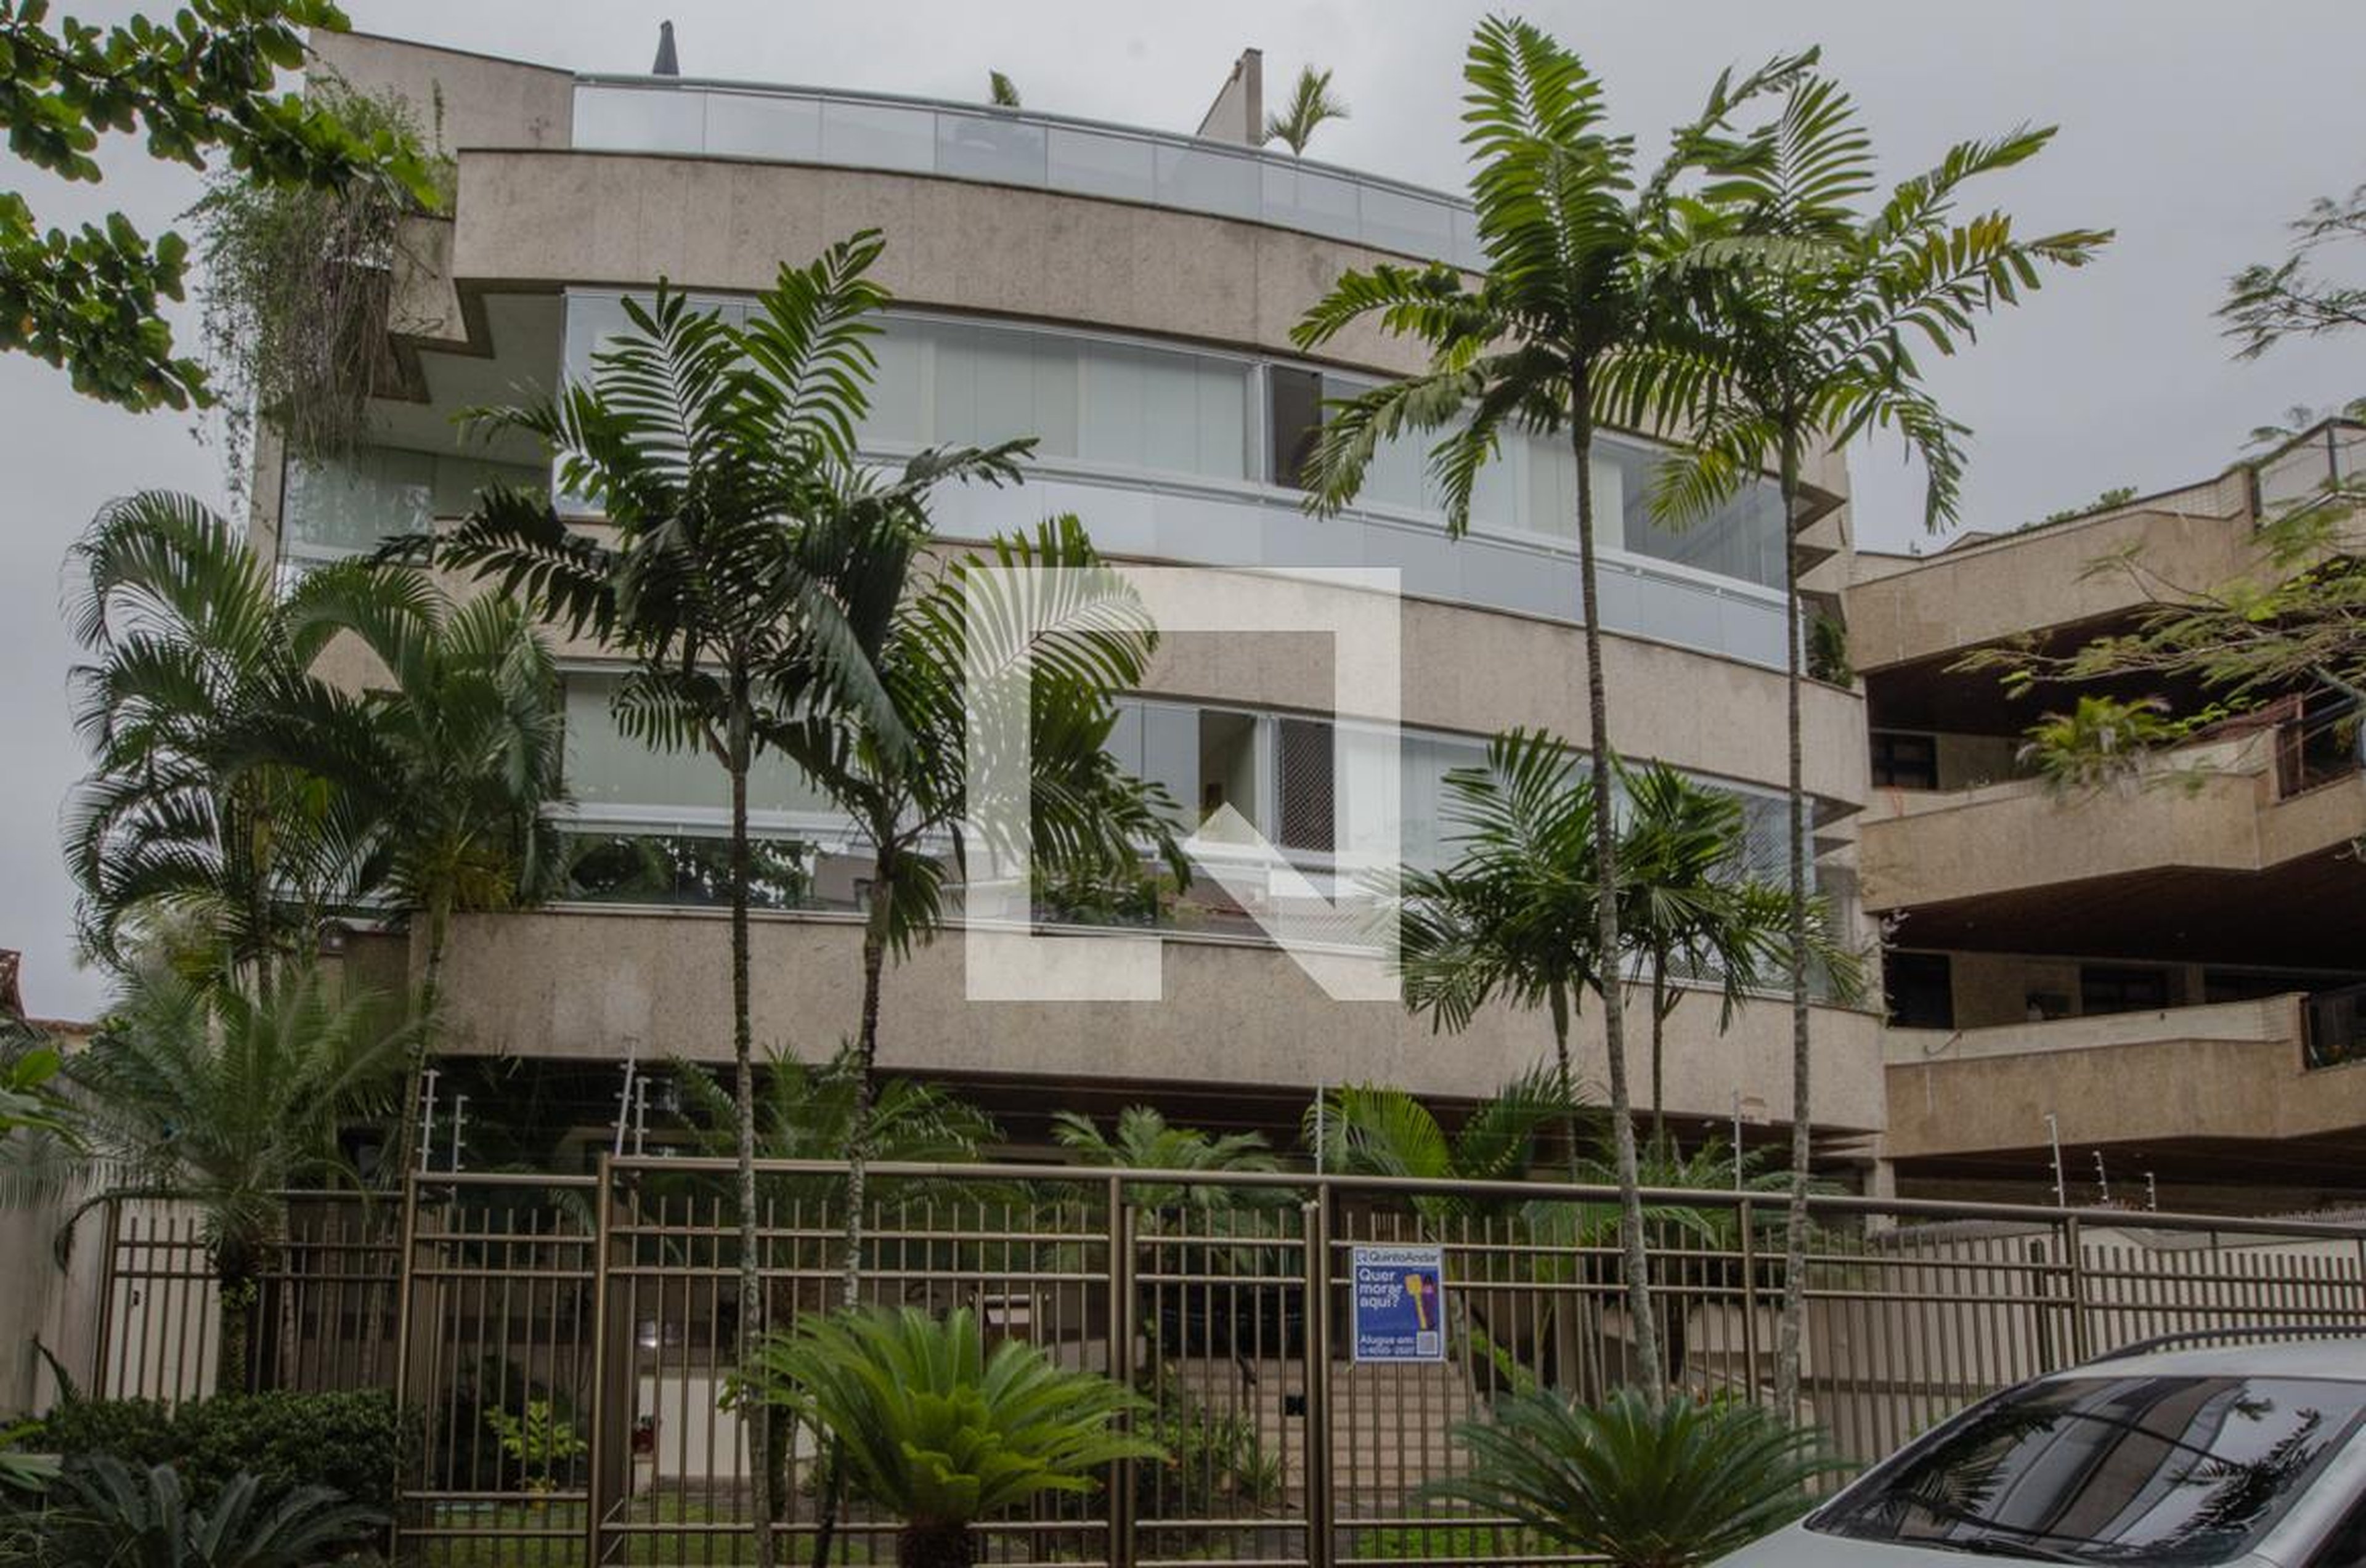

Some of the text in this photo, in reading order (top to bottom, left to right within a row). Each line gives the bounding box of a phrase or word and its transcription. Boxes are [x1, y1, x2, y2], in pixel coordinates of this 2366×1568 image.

[1359, 1268, 1396, 1282] Quer
[1359, 1284, 1403, 1294] morar
[1360, 1296, 1400, 1310] aqui?
